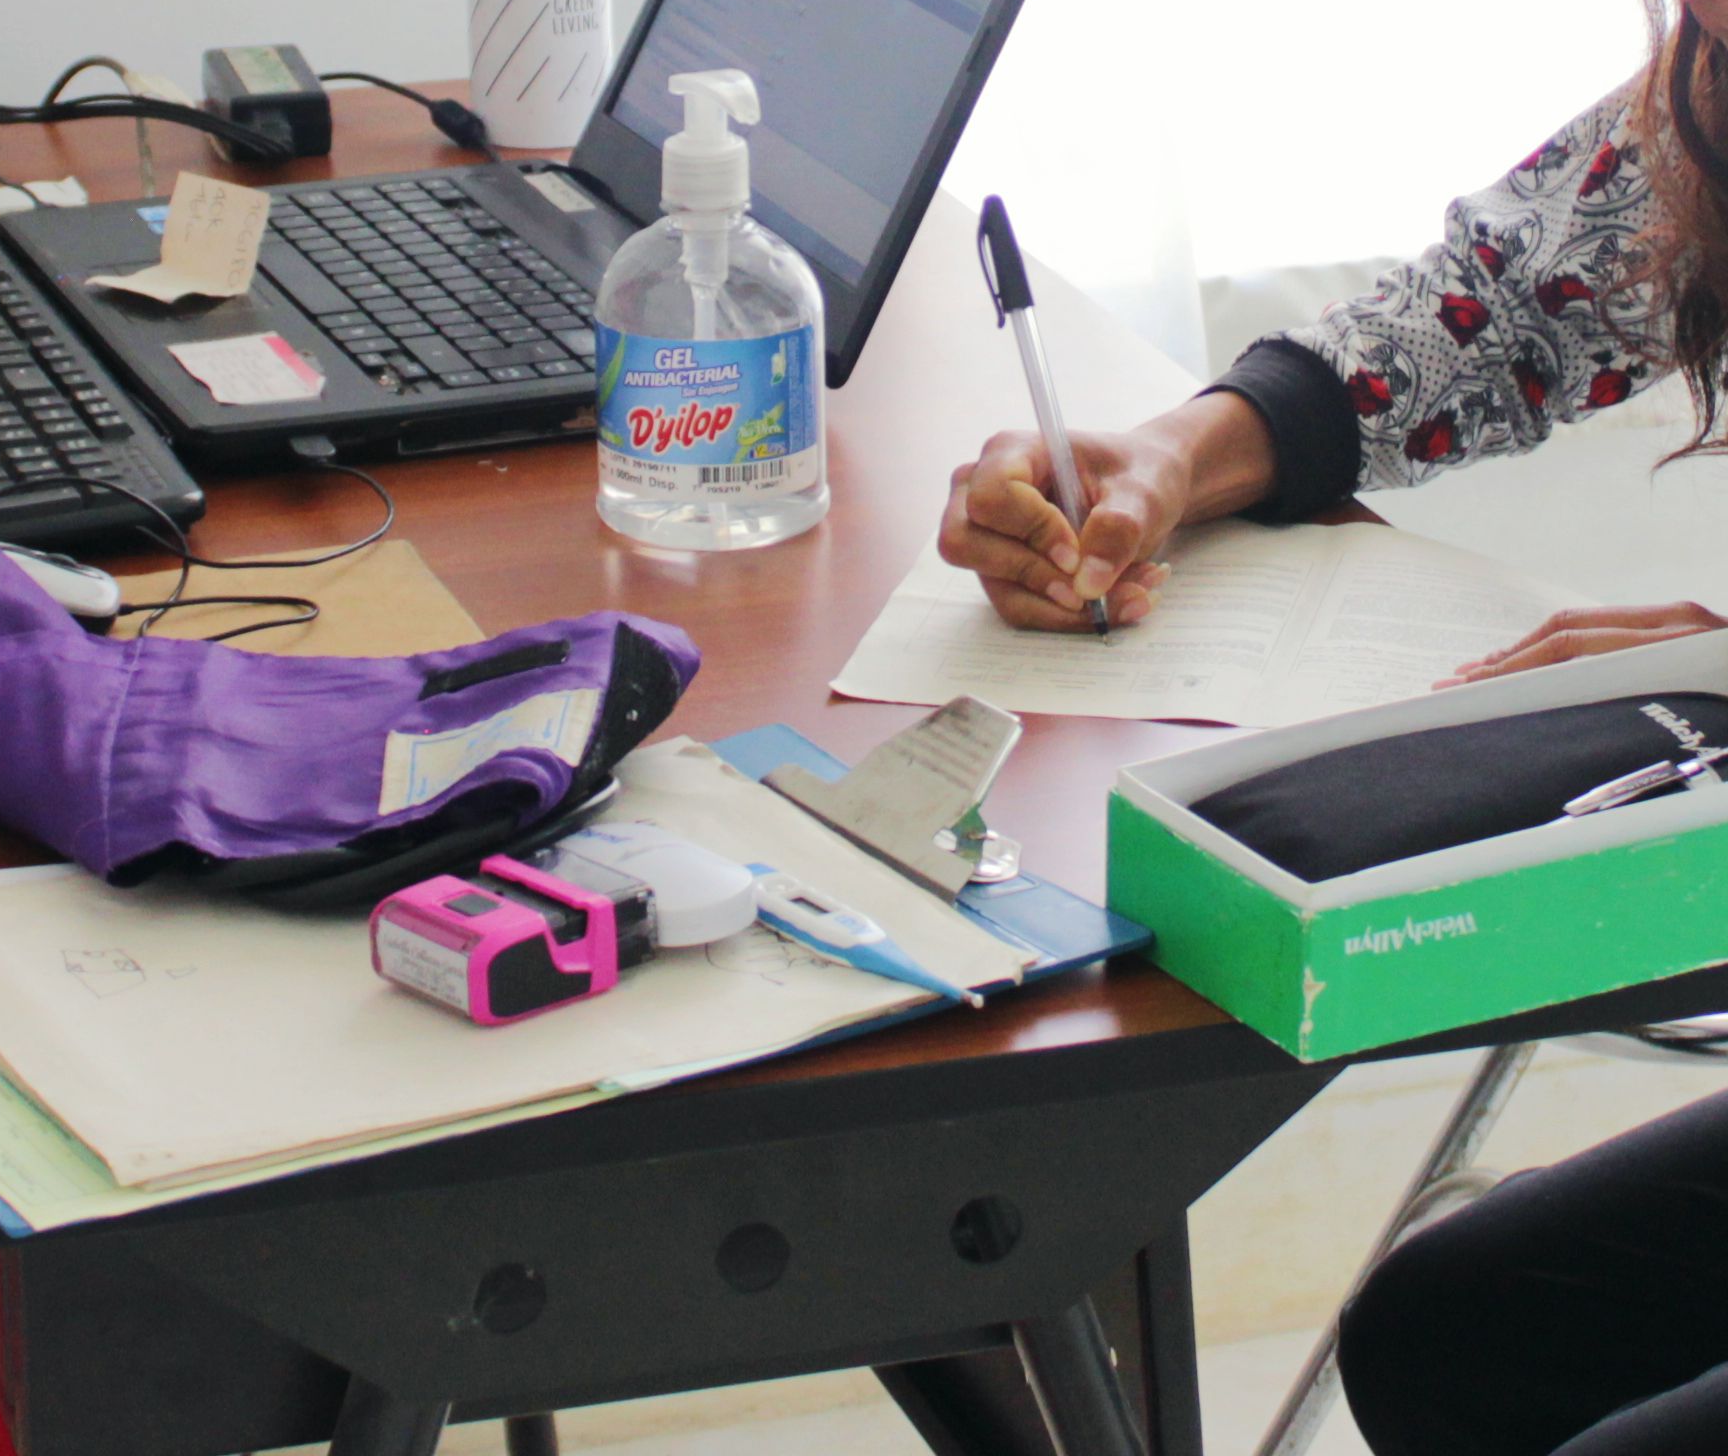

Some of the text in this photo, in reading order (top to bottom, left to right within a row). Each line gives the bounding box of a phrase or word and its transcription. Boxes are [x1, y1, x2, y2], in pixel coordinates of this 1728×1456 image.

[552, 13, 600, 35] LIVING
[654, 347, 697, 370] GEL
[624, 363, 741, 387] ANTIBACTERIAL
